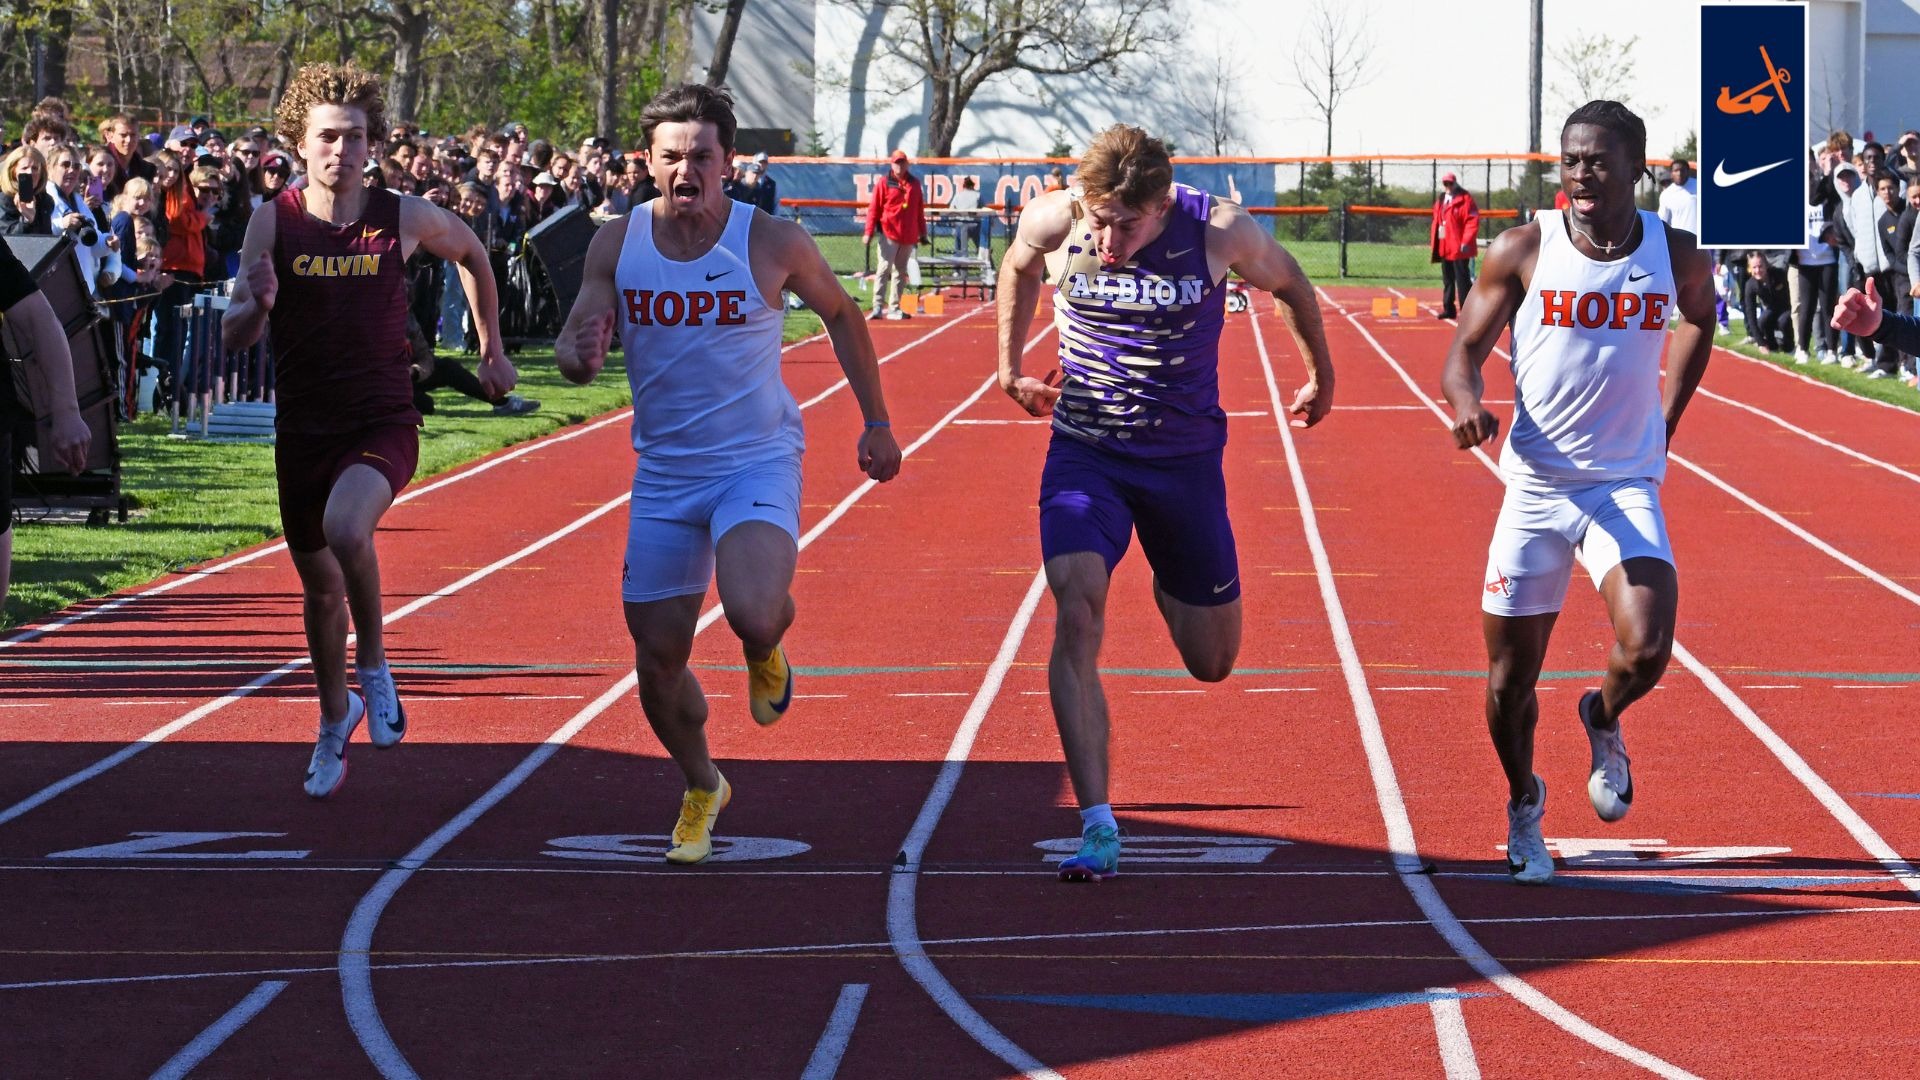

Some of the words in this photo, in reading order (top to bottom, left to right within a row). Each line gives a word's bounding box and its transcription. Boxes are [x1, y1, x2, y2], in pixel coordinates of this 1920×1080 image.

[292, 254, 381, 277] CALVIN
[1069, 272, 1203, 306] ALBION
[623, 289, 746, 327] HOPE
[1540, 289, 1669, 331] HOPE
